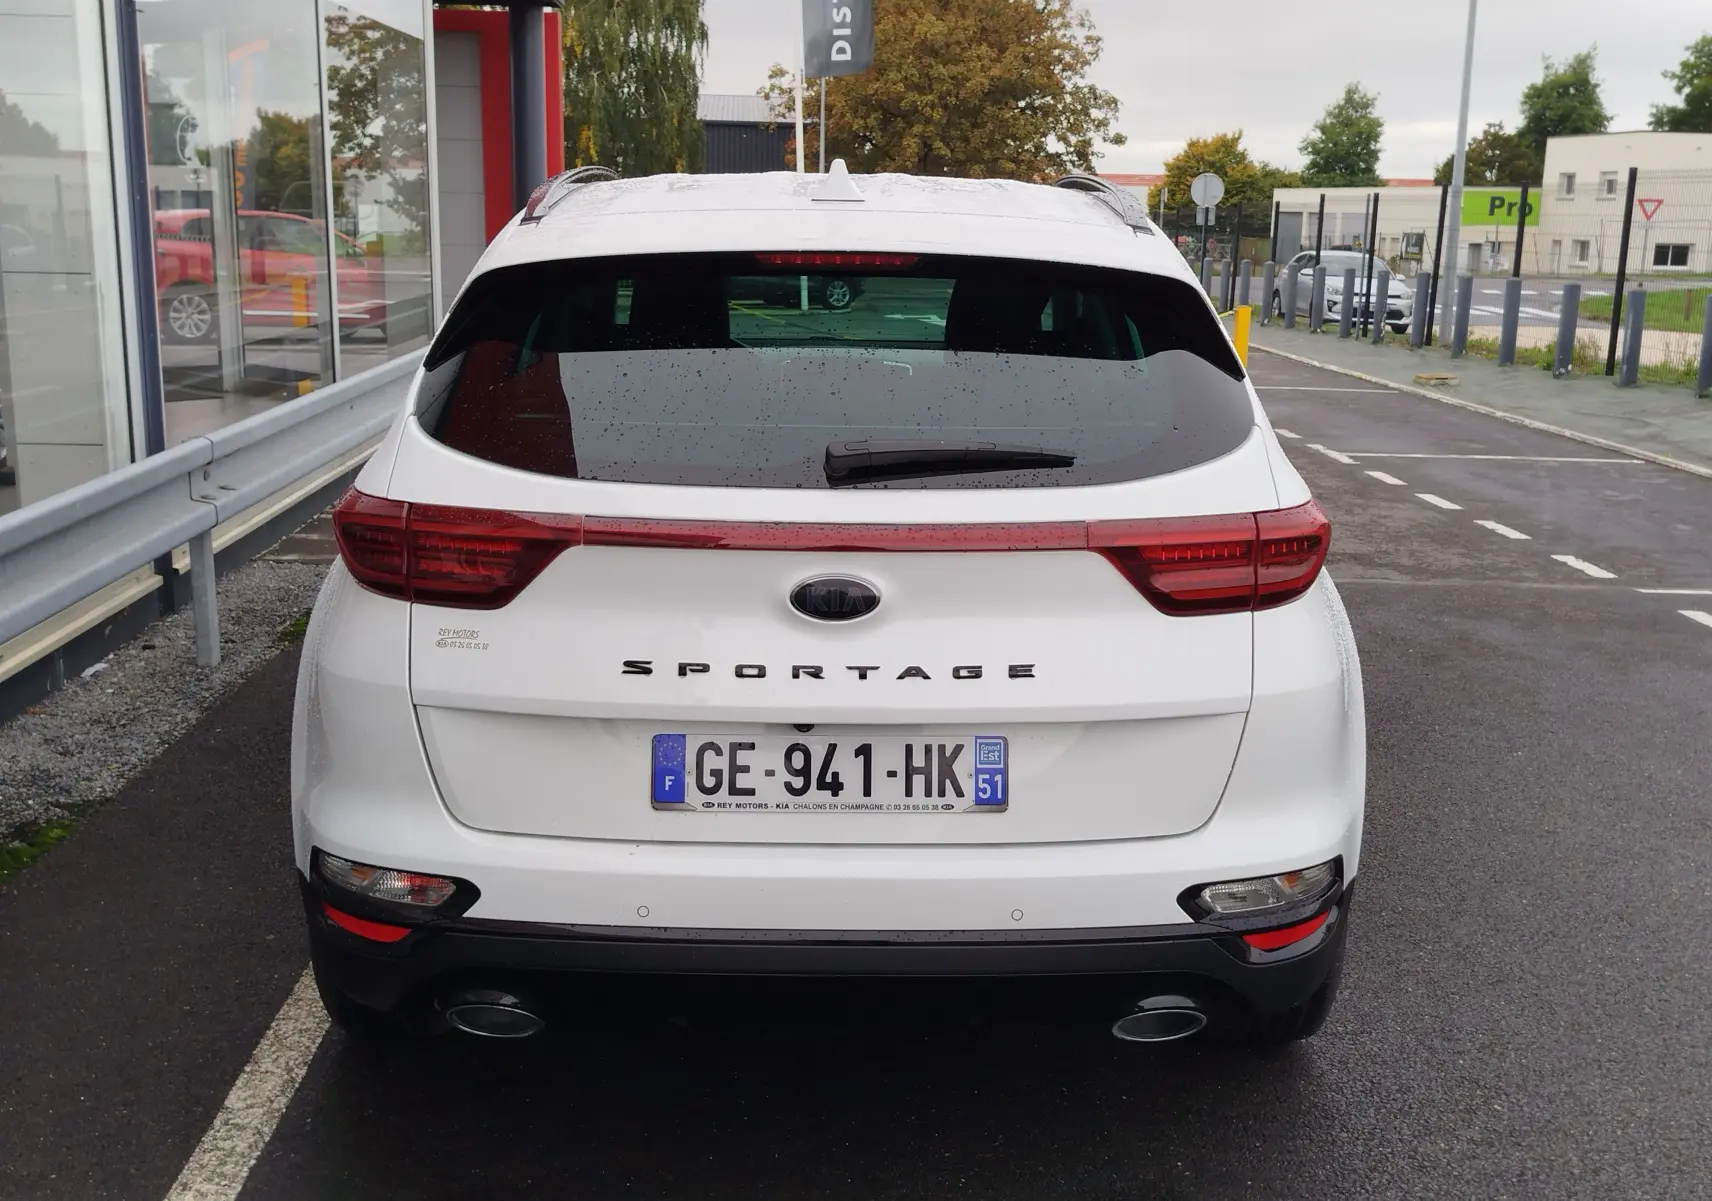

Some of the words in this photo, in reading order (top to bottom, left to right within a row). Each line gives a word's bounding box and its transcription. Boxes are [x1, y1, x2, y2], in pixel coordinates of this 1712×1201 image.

[831, 0, 852, 61] DIS
[805, 586, 866, 612] KIA
[438, 628, 452, 637] REY
[453, 629, 480, 638] MOTORS
[621, 660, 1037, 681] SPORTAGE
[980, 750, 1000, 761] Est
[695, 741, 967, 799] GE-941-HK
[664, 775, 675, 791] F
[978, 773, 1002, 800] 51
[840, 803, 884, 811] CHAMPAGNE
